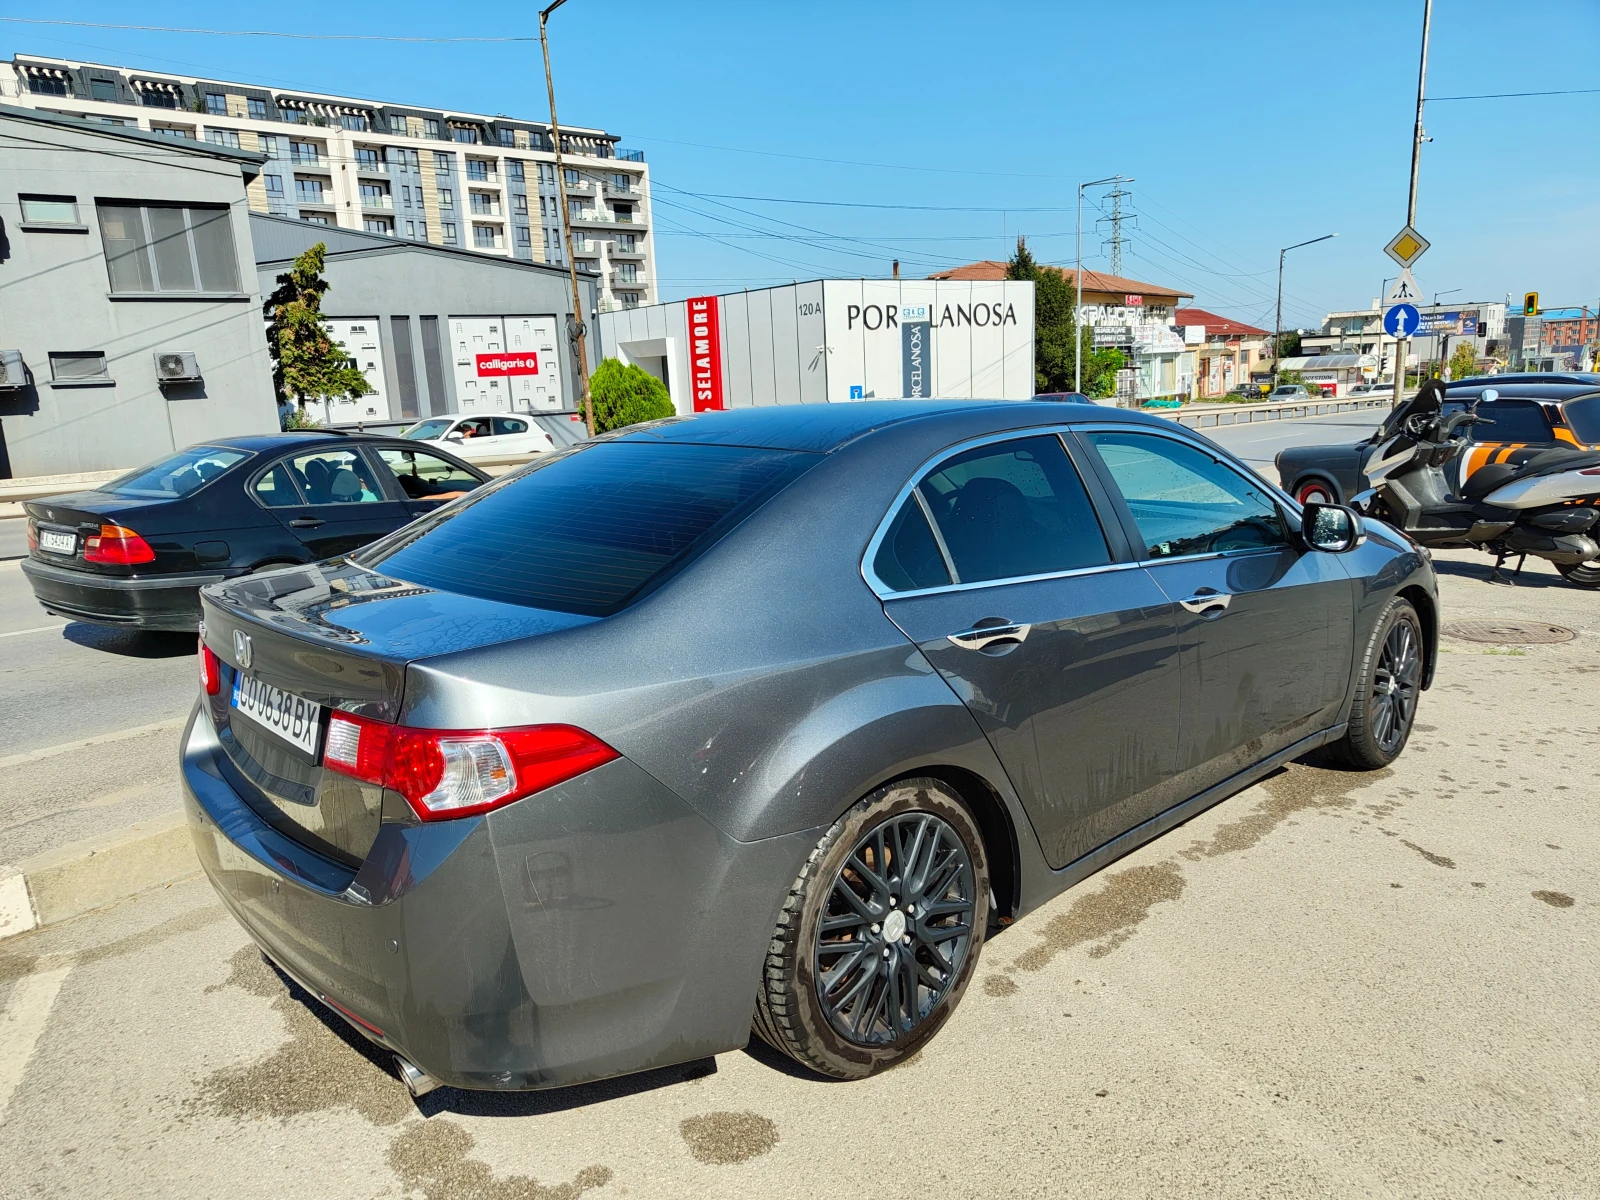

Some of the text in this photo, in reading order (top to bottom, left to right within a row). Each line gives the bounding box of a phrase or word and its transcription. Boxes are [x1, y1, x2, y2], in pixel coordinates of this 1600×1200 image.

[799, 302, 822, 316] 120 A
[847, 302, 1017, 330] PORLANOSA
[692, 300, 713, 400] SELAMORE
[480, 358, 525, 371] calligaris
